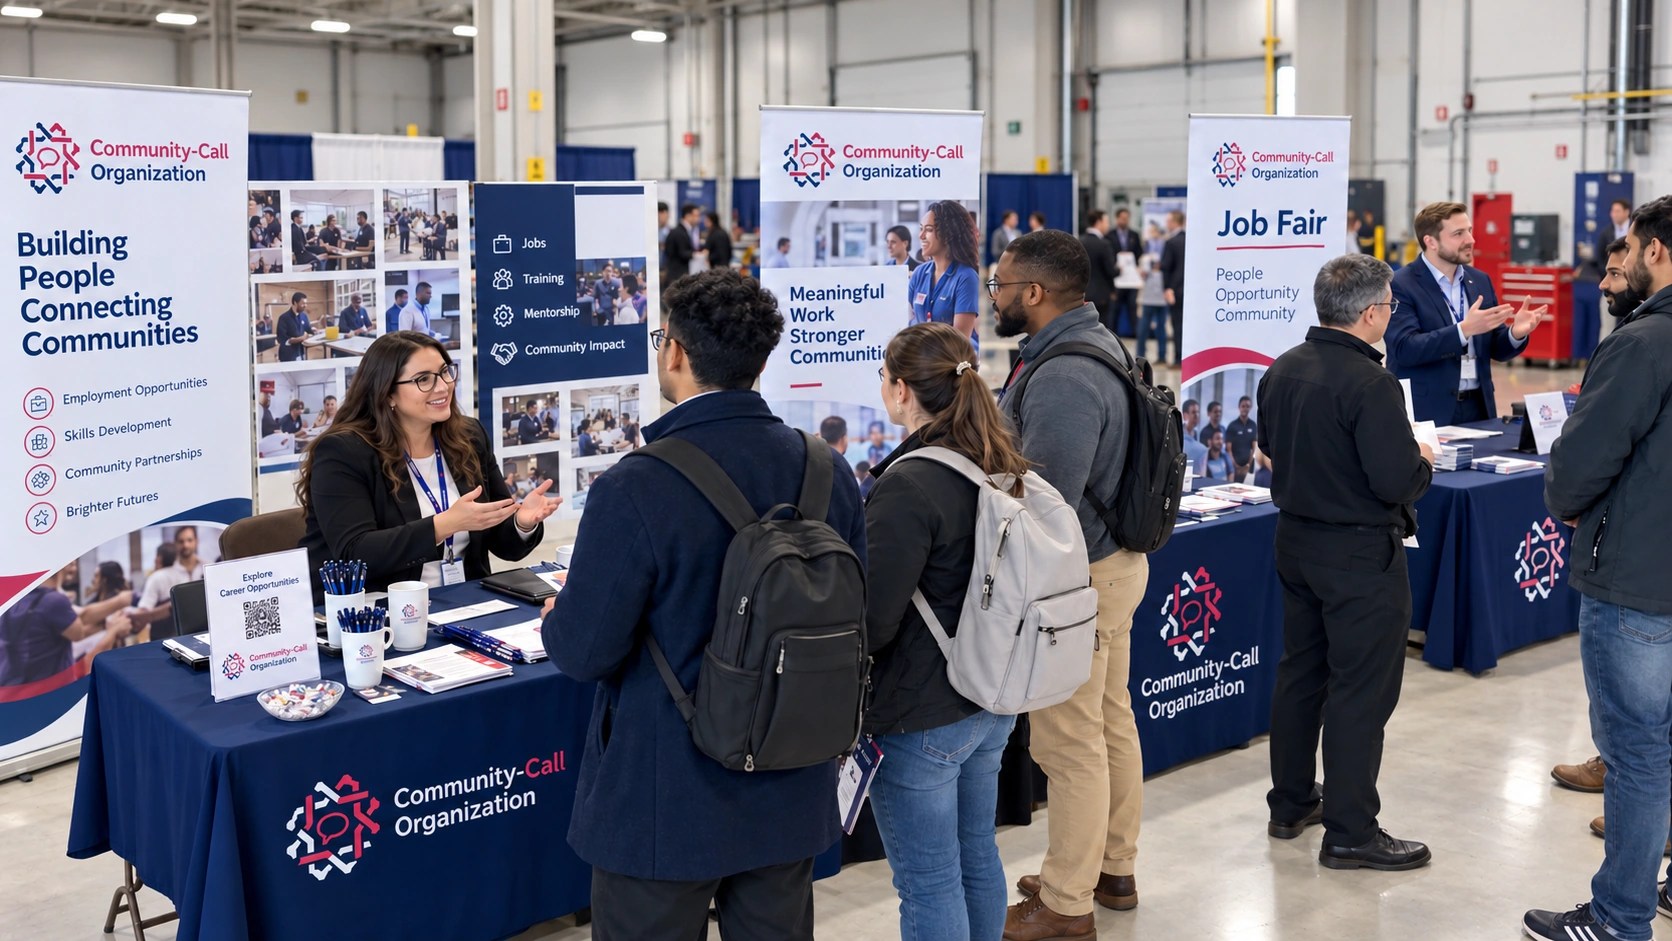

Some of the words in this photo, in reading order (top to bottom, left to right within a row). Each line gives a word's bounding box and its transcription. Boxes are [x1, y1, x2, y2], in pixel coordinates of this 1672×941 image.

[90, 139, 229, 162] Community-Call
[843, 144, 964, 162] Community-Call
[1252, 151, 1334, 165] Community-Call
[91, 164, 206, 184] Organization
[843, 164, 941, 181] Organization
[1252, 167, 1318, 181] Organization
[1217, 209, 1268, 236] Job
[1278, 209, 1327, 235] Fair
[17, 230, 128, 260] Building
[522, 237, 546, 250] Jobs
[19, 262, 115, 294] People
[522, 273, 564, 287] Training
[1216, 266, 1263, 283] People
[790, 283, 884, 304] Meaningful
[1216, 286, 1299, 304] Opportunity
[20, 292, 172, 324] Connecting
[524, 306, 580, 319] Mentorship
[790, 306, 834, 322] Work
[1215, 306, 1296, 323] Community
[22, 322, 198, 356] Communities
[790, 328, 865, 346] Stronger
[525, 341, 586, 357] Community
[589, 339, 625, 351] Impact
[63, 385, 132, 406] Employment
[135, 377, 208, 396] Opportunities
[64, 427, 95, 442] Skills
[99, 417, 172, 437] Development
[65, 459, 132, 480] Community
[135, 448, 202, 467] Partnerships
[66, 501, 114, 518] Brighter
[117, 491, 159, 508] Futures
[243, 571, 273, 582] Explore
[220, 587, 245, 597] Career
[247, 577, 299, 592] Opportunities
[250, 656, 297, 671] Organization
[1141, 646, 1259, 697] Community-Call
[1149, 677, 1245, 720] Organization
[394, 750, 566, 808] Community-Call
[394, 790, 536, 837] Organization
